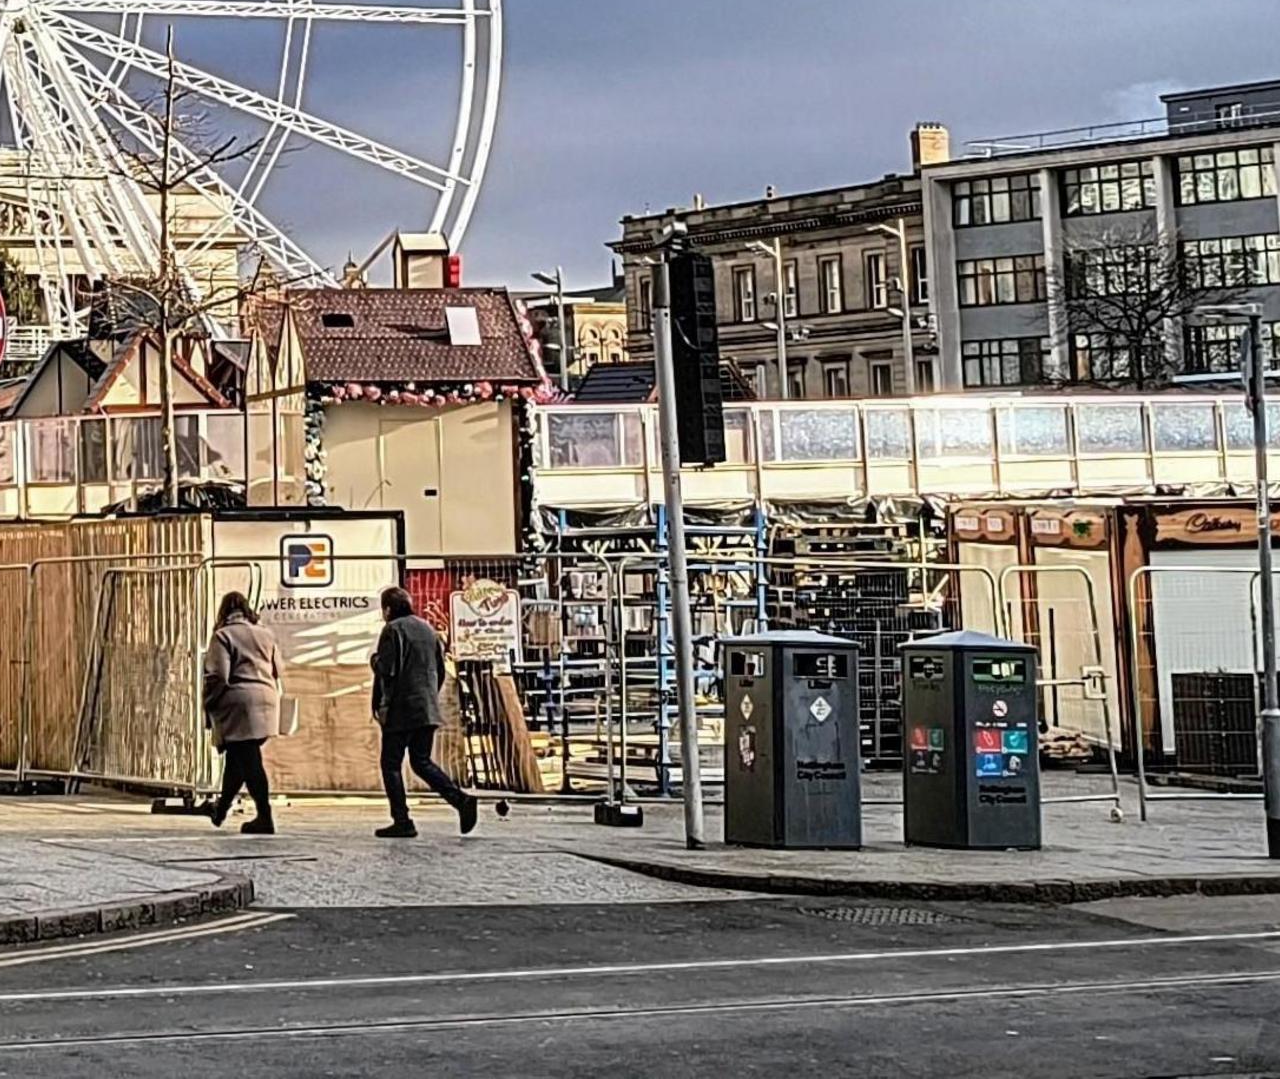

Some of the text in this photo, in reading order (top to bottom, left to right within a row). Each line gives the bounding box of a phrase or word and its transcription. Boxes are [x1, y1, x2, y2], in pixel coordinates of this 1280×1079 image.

[300, 596, 369, 609] ELECTRICS
[796, 760, 845, 771] Nottingham
[815, 771, 846, 779] Council
